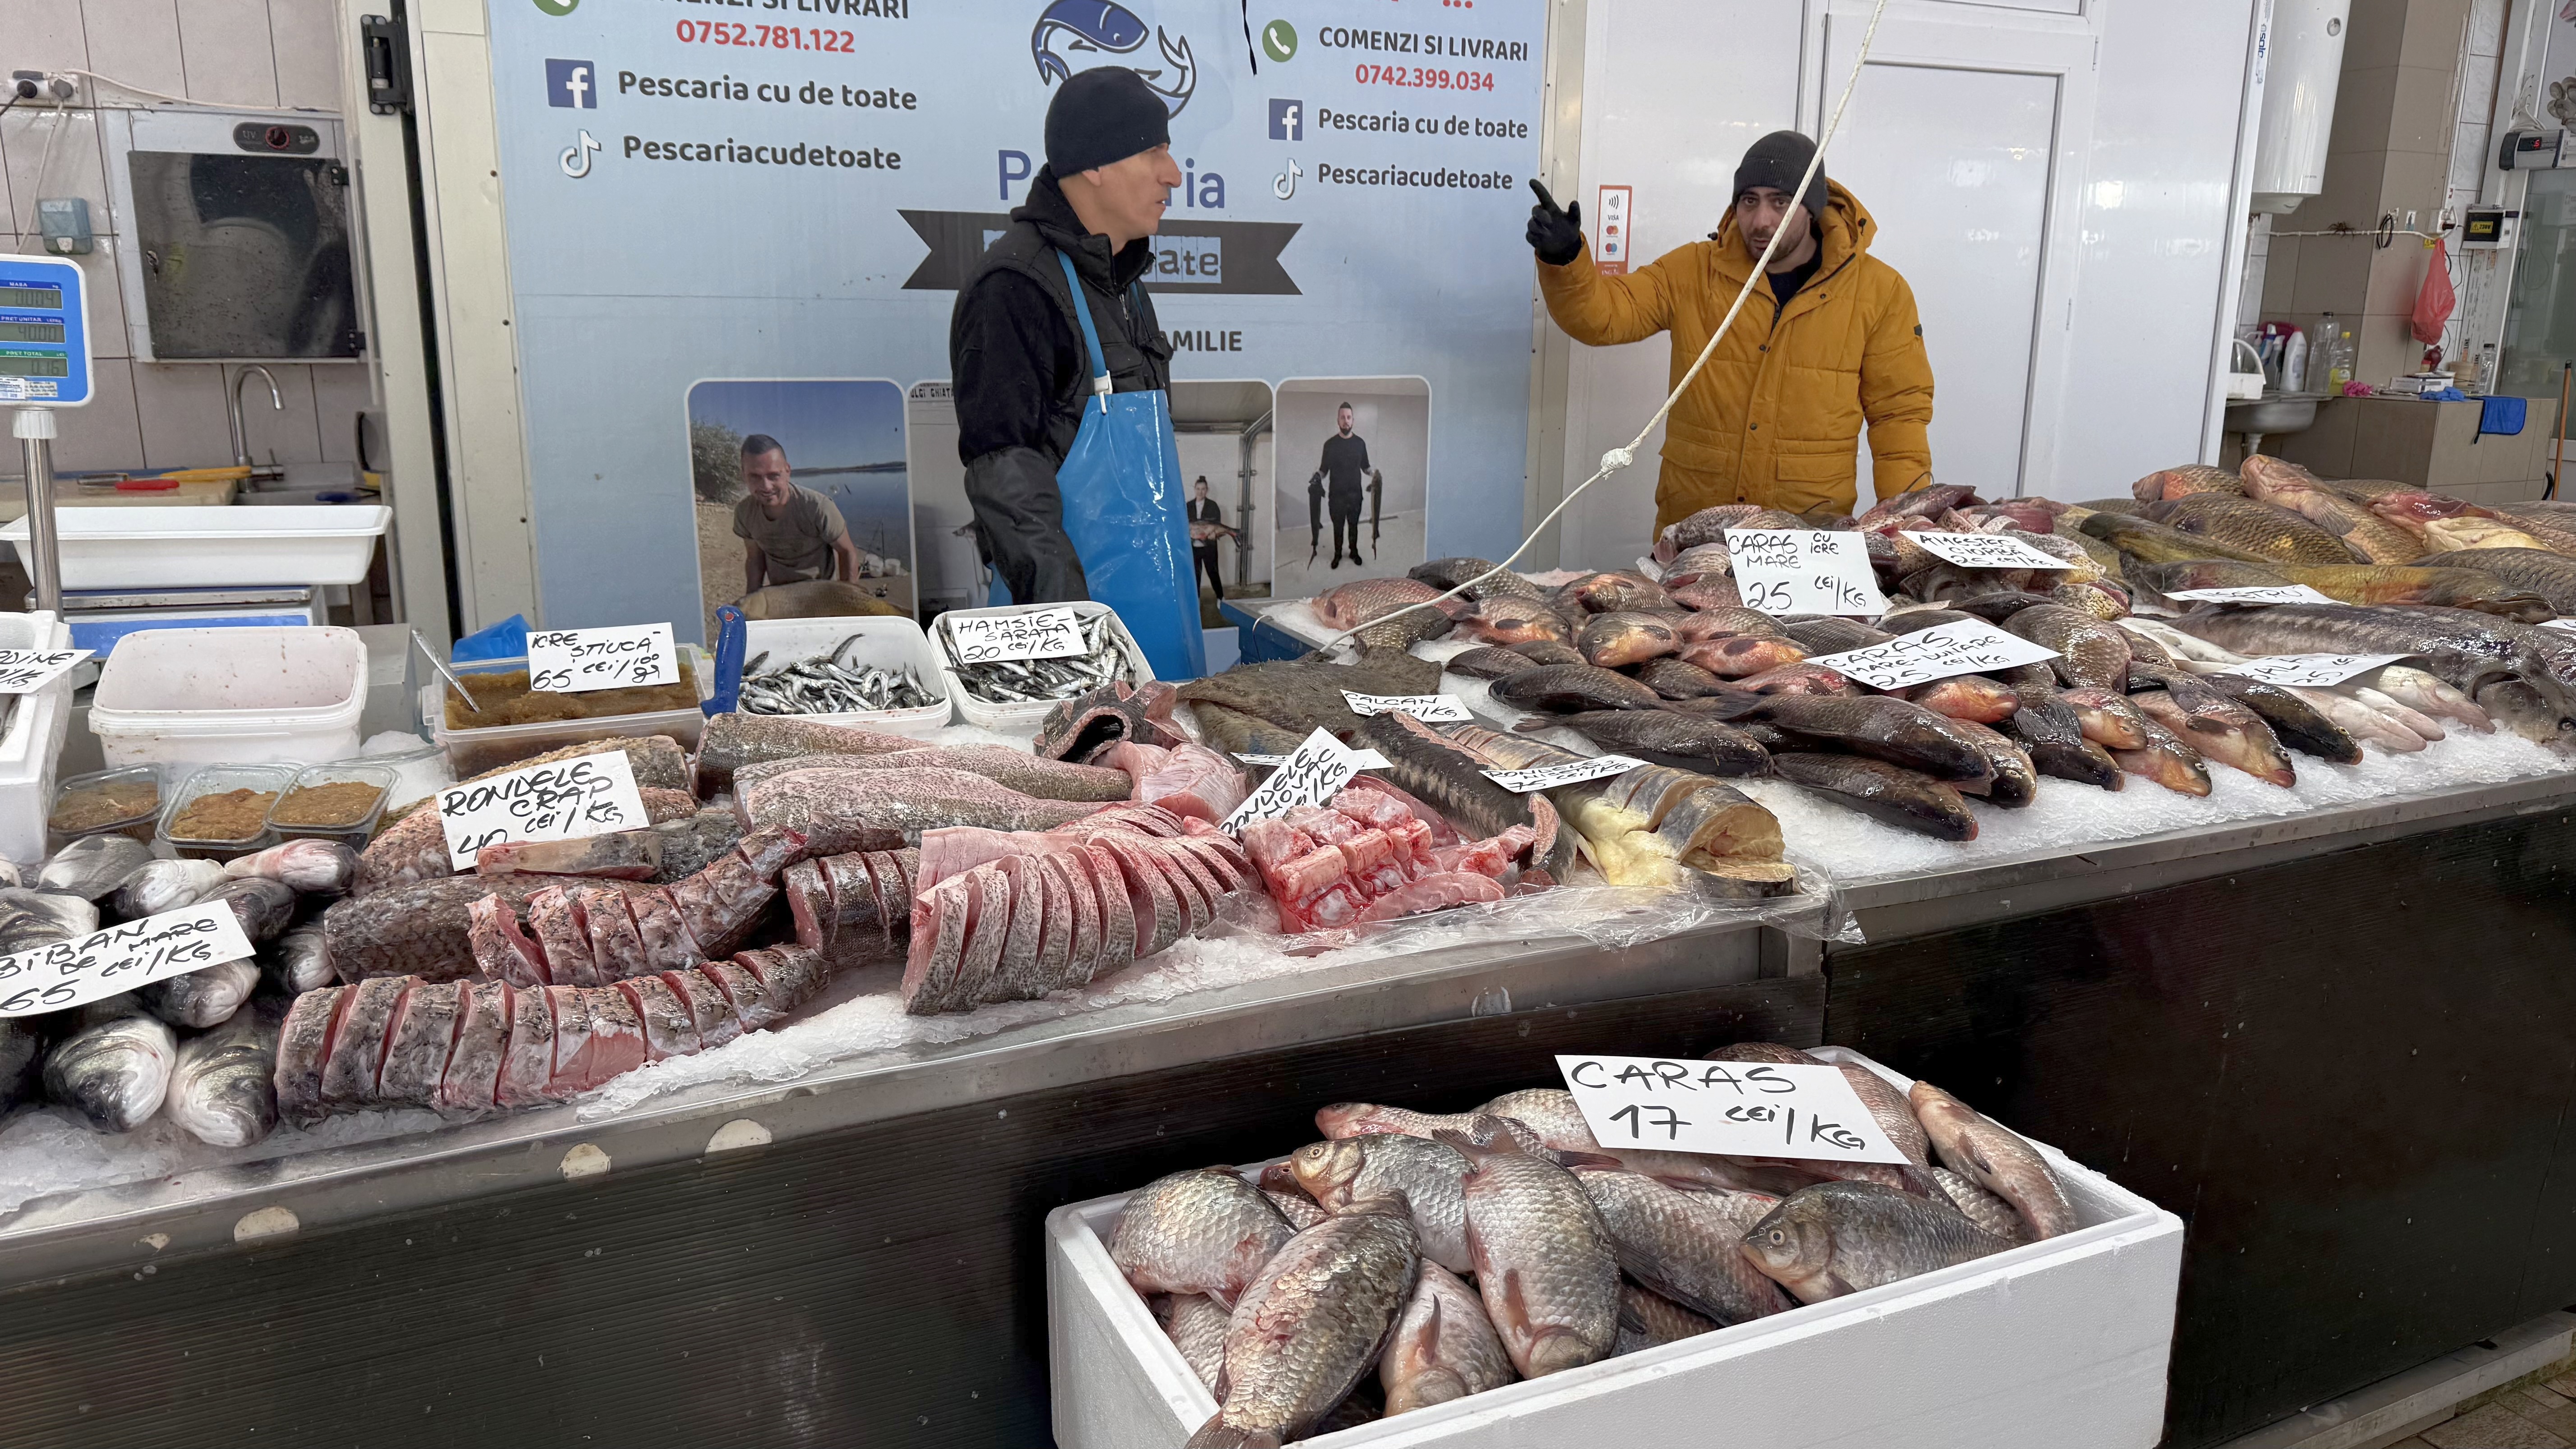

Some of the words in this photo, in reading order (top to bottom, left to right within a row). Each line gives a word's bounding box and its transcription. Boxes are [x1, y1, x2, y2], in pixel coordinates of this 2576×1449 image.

[676, 19, 855, 53] 0752.781.122
[1319, 27, 1418, 53] COMENZI
[1425, 35, 1442, 55] SI
[1449, 37, 1527, 61] LIVRARI
[618, 70, 749, 102] Pescaria
[757, 84, 790, 104] cu
[799, 81, 833, 106] de
[842, 84, 917, 110] toate
[1356, 64, 1494, 92] 0742.399.034
[1319, 108, 1409, 133] Pescaria
[1415, 118, 1439, 135] cu
[1444, 115, 1470, 137] de
[1475, 117, 1528, 139] toate
[624, 136, 902, 170] Pescariacudetoate
[1319, 163, 1512, 190] Pescariacudetoate
[1144, 246, 1219, 276] ate
[1160, 330, 1242, 352] MILIE
[1813, 533, 1831, 543] CU
[1747, 555, 1801, 569] MARE
[1950, 555, 1994, 565] 25
[1747, 581, 1792, 610] 25
[964, 645, 1000, 660] 20
[533, 669, 573, 689] 65
[1869, 669, 1932, 687] 25
[1345, 693, 1437, 705] CALCAN
[442, 762, 593, 817] RONDELE
[510, 776, 613, 817] CRAP
[1506, 779, 1547, 790] 75
[129, 919, 218, 952] MARE
[0, 979, 81, 1011] 65
[1571, 1061, 1797, 1095] CARAS
[1609, 1104, 1692, 1140] 17
